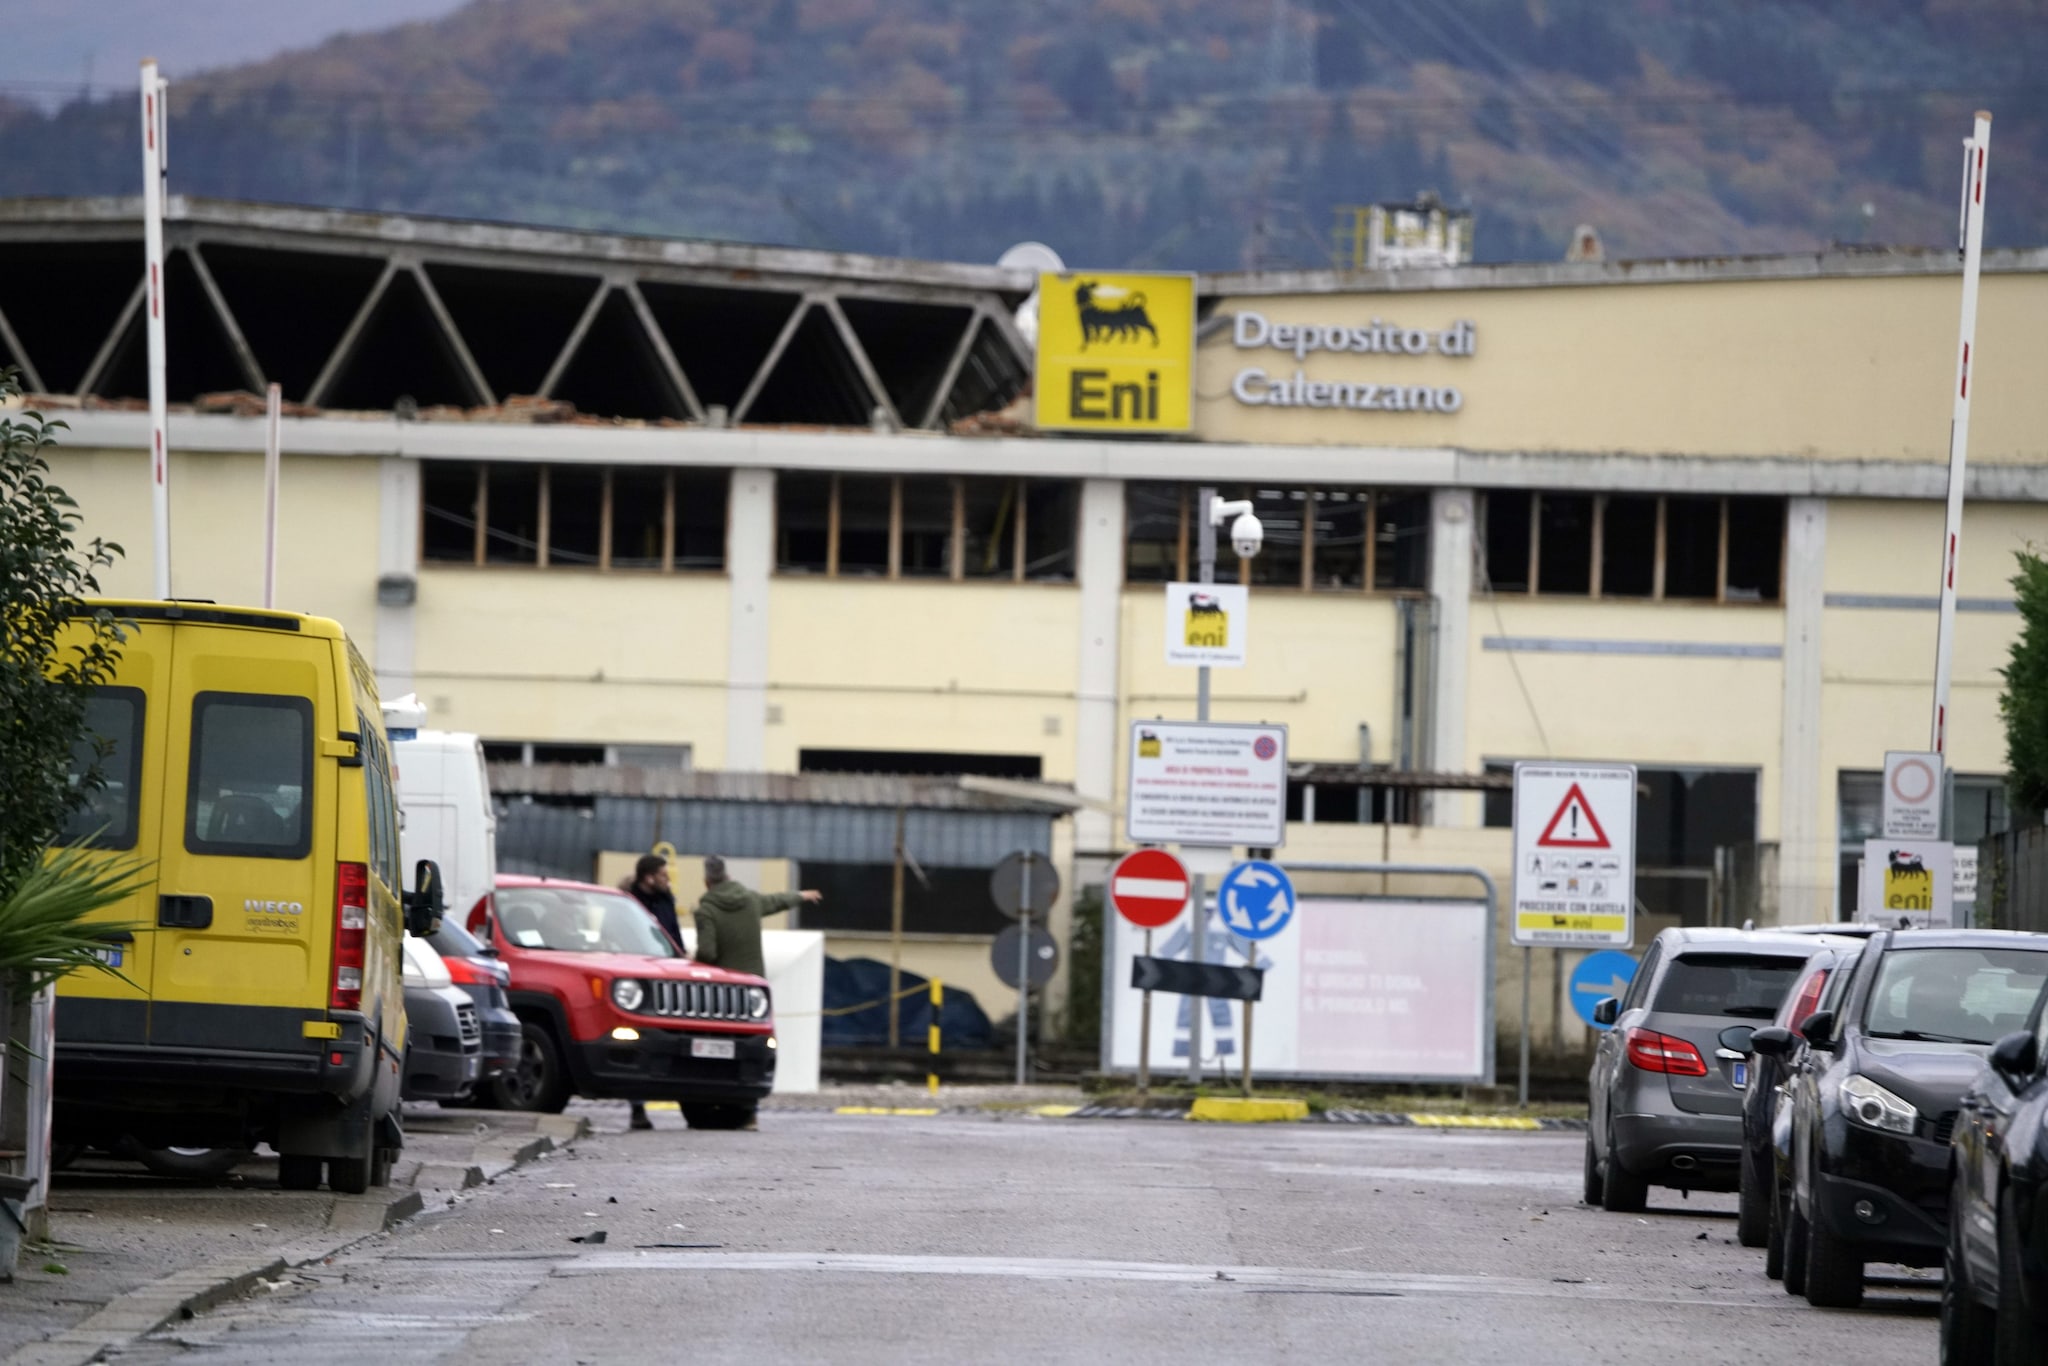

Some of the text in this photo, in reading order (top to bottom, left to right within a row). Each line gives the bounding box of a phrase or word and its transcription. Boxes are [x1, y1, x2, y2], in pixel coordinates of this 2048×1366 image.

[1232, 310, 1477, 359] Deposito di
[1069, 369, 1159, 422] Eni
[1232, 367, 1463, 414] Calenzano
[1188, 625, 1225, 647] eni
[244, 899, 304, 916] IVECO
[1519, 901, 1626, 914] PROCEDERE CON CAUTELA
[1889, 886, 1928, 910] eni
